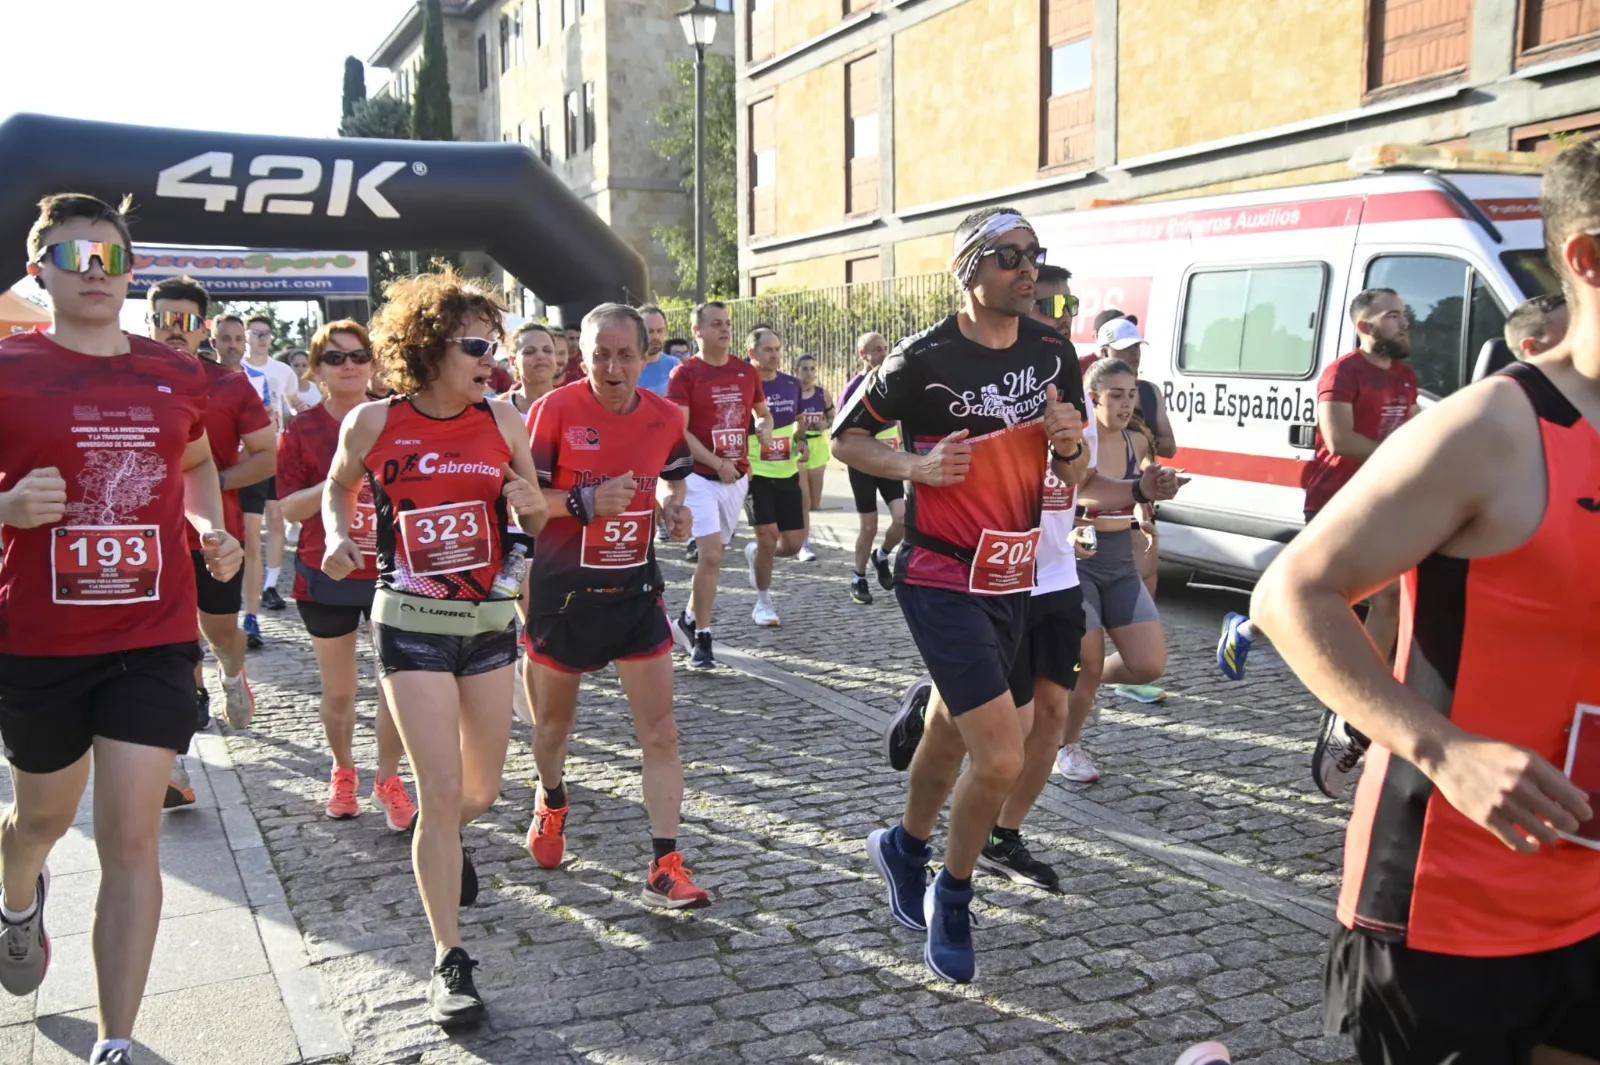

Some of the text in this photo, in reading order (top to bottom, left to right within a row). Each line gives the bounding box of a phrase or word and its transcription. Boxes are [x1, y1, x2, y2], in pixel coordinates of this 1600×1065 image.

[156, 151, 407, 219] 42K
[1166, 212, 1232, 239] Primeros
[1234, 207, 1301, 231] Auxilios
[131, 253, 356, 273] ycronSport
[938, 388, 1047, 418] Salamanca
[1163, 381, 1316, 427] Roja Española
[719, 433, 743, 446] 198
[415, 511, 479, 544] 323
[604, 520, 638, 542] 52
[69, 537, 148, 567] 193
[986, 540, 1033, 565] 202
[420, 606, 476, 618] LURBEL
